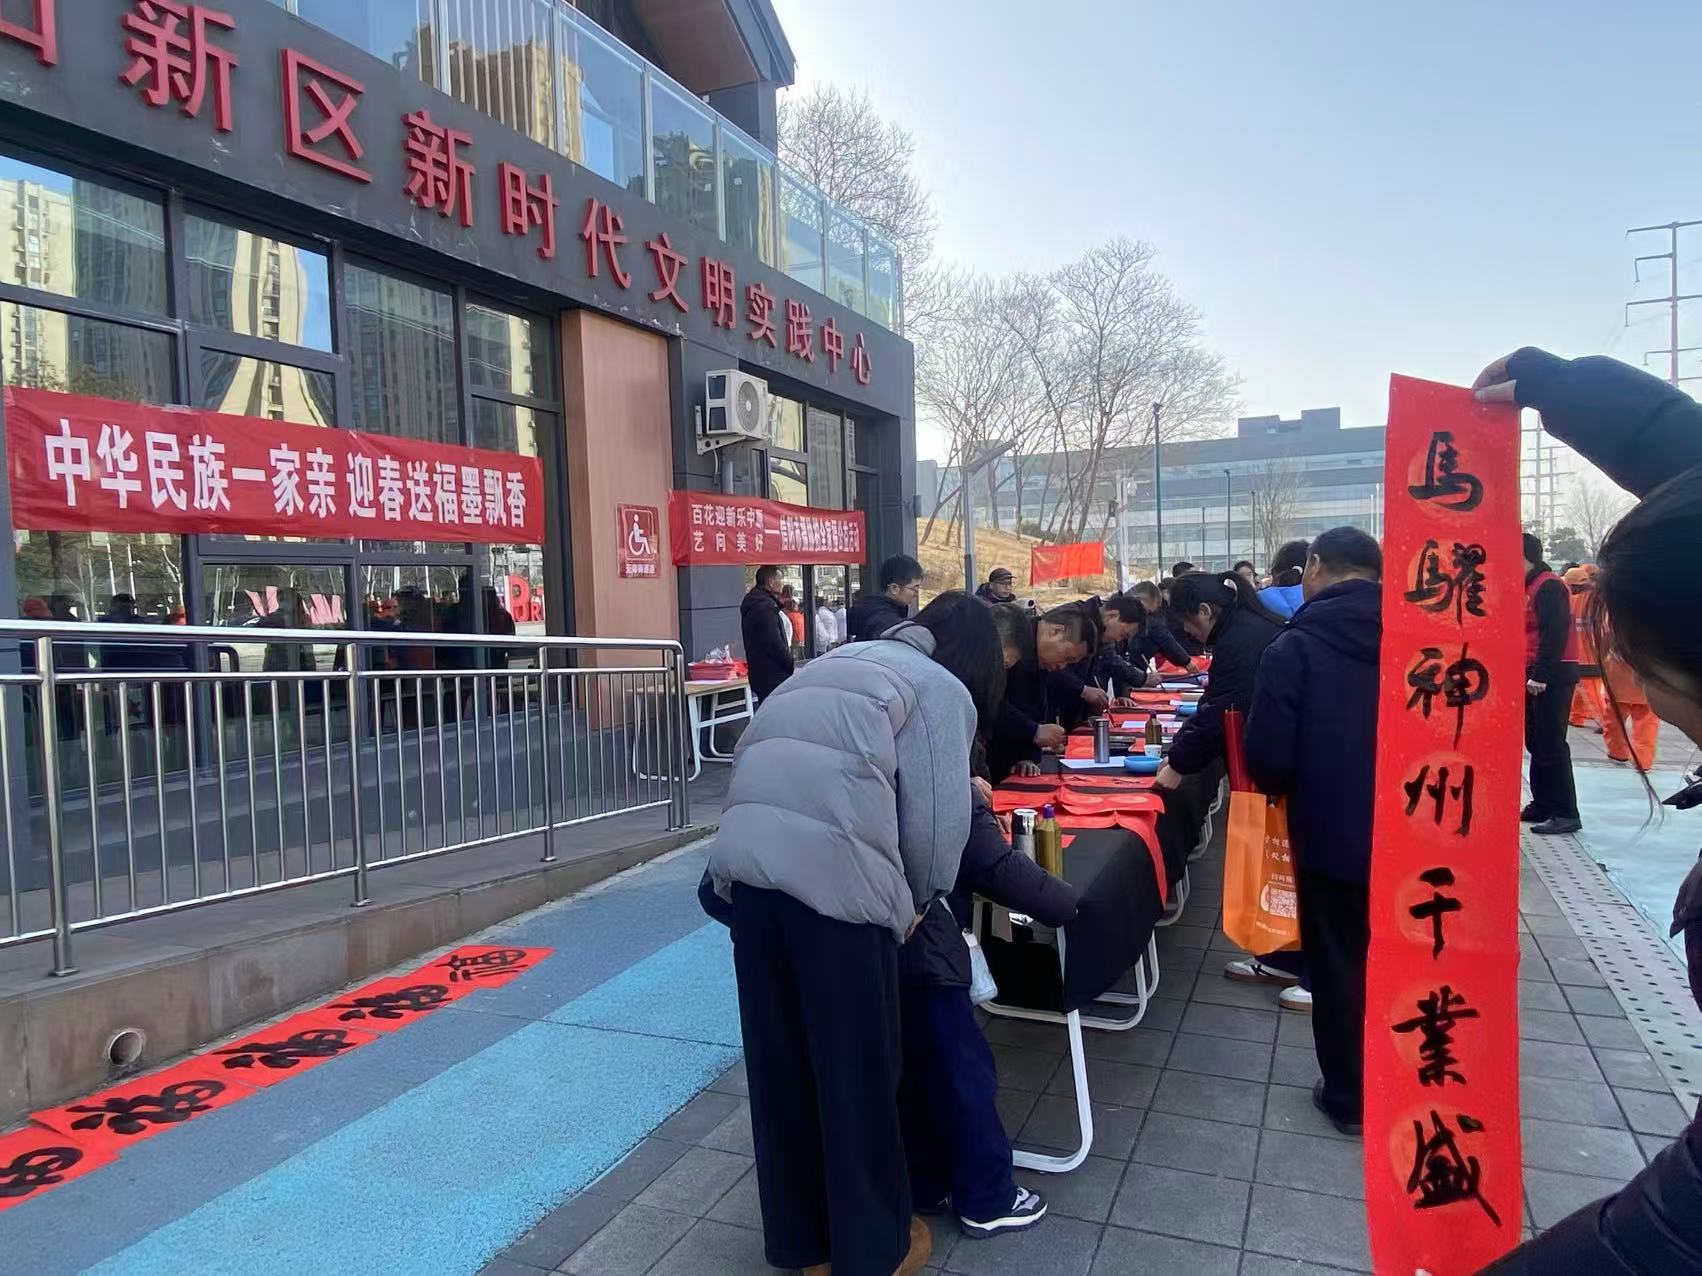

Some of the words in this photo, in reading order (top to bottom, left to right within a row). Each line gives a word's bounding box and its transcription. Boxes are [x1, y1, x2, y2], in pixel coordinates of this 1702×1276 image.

[44, 418, 337, 519] 中华民族一家亲
[345, 451, 528, 528] 迎春送福墨飘香
